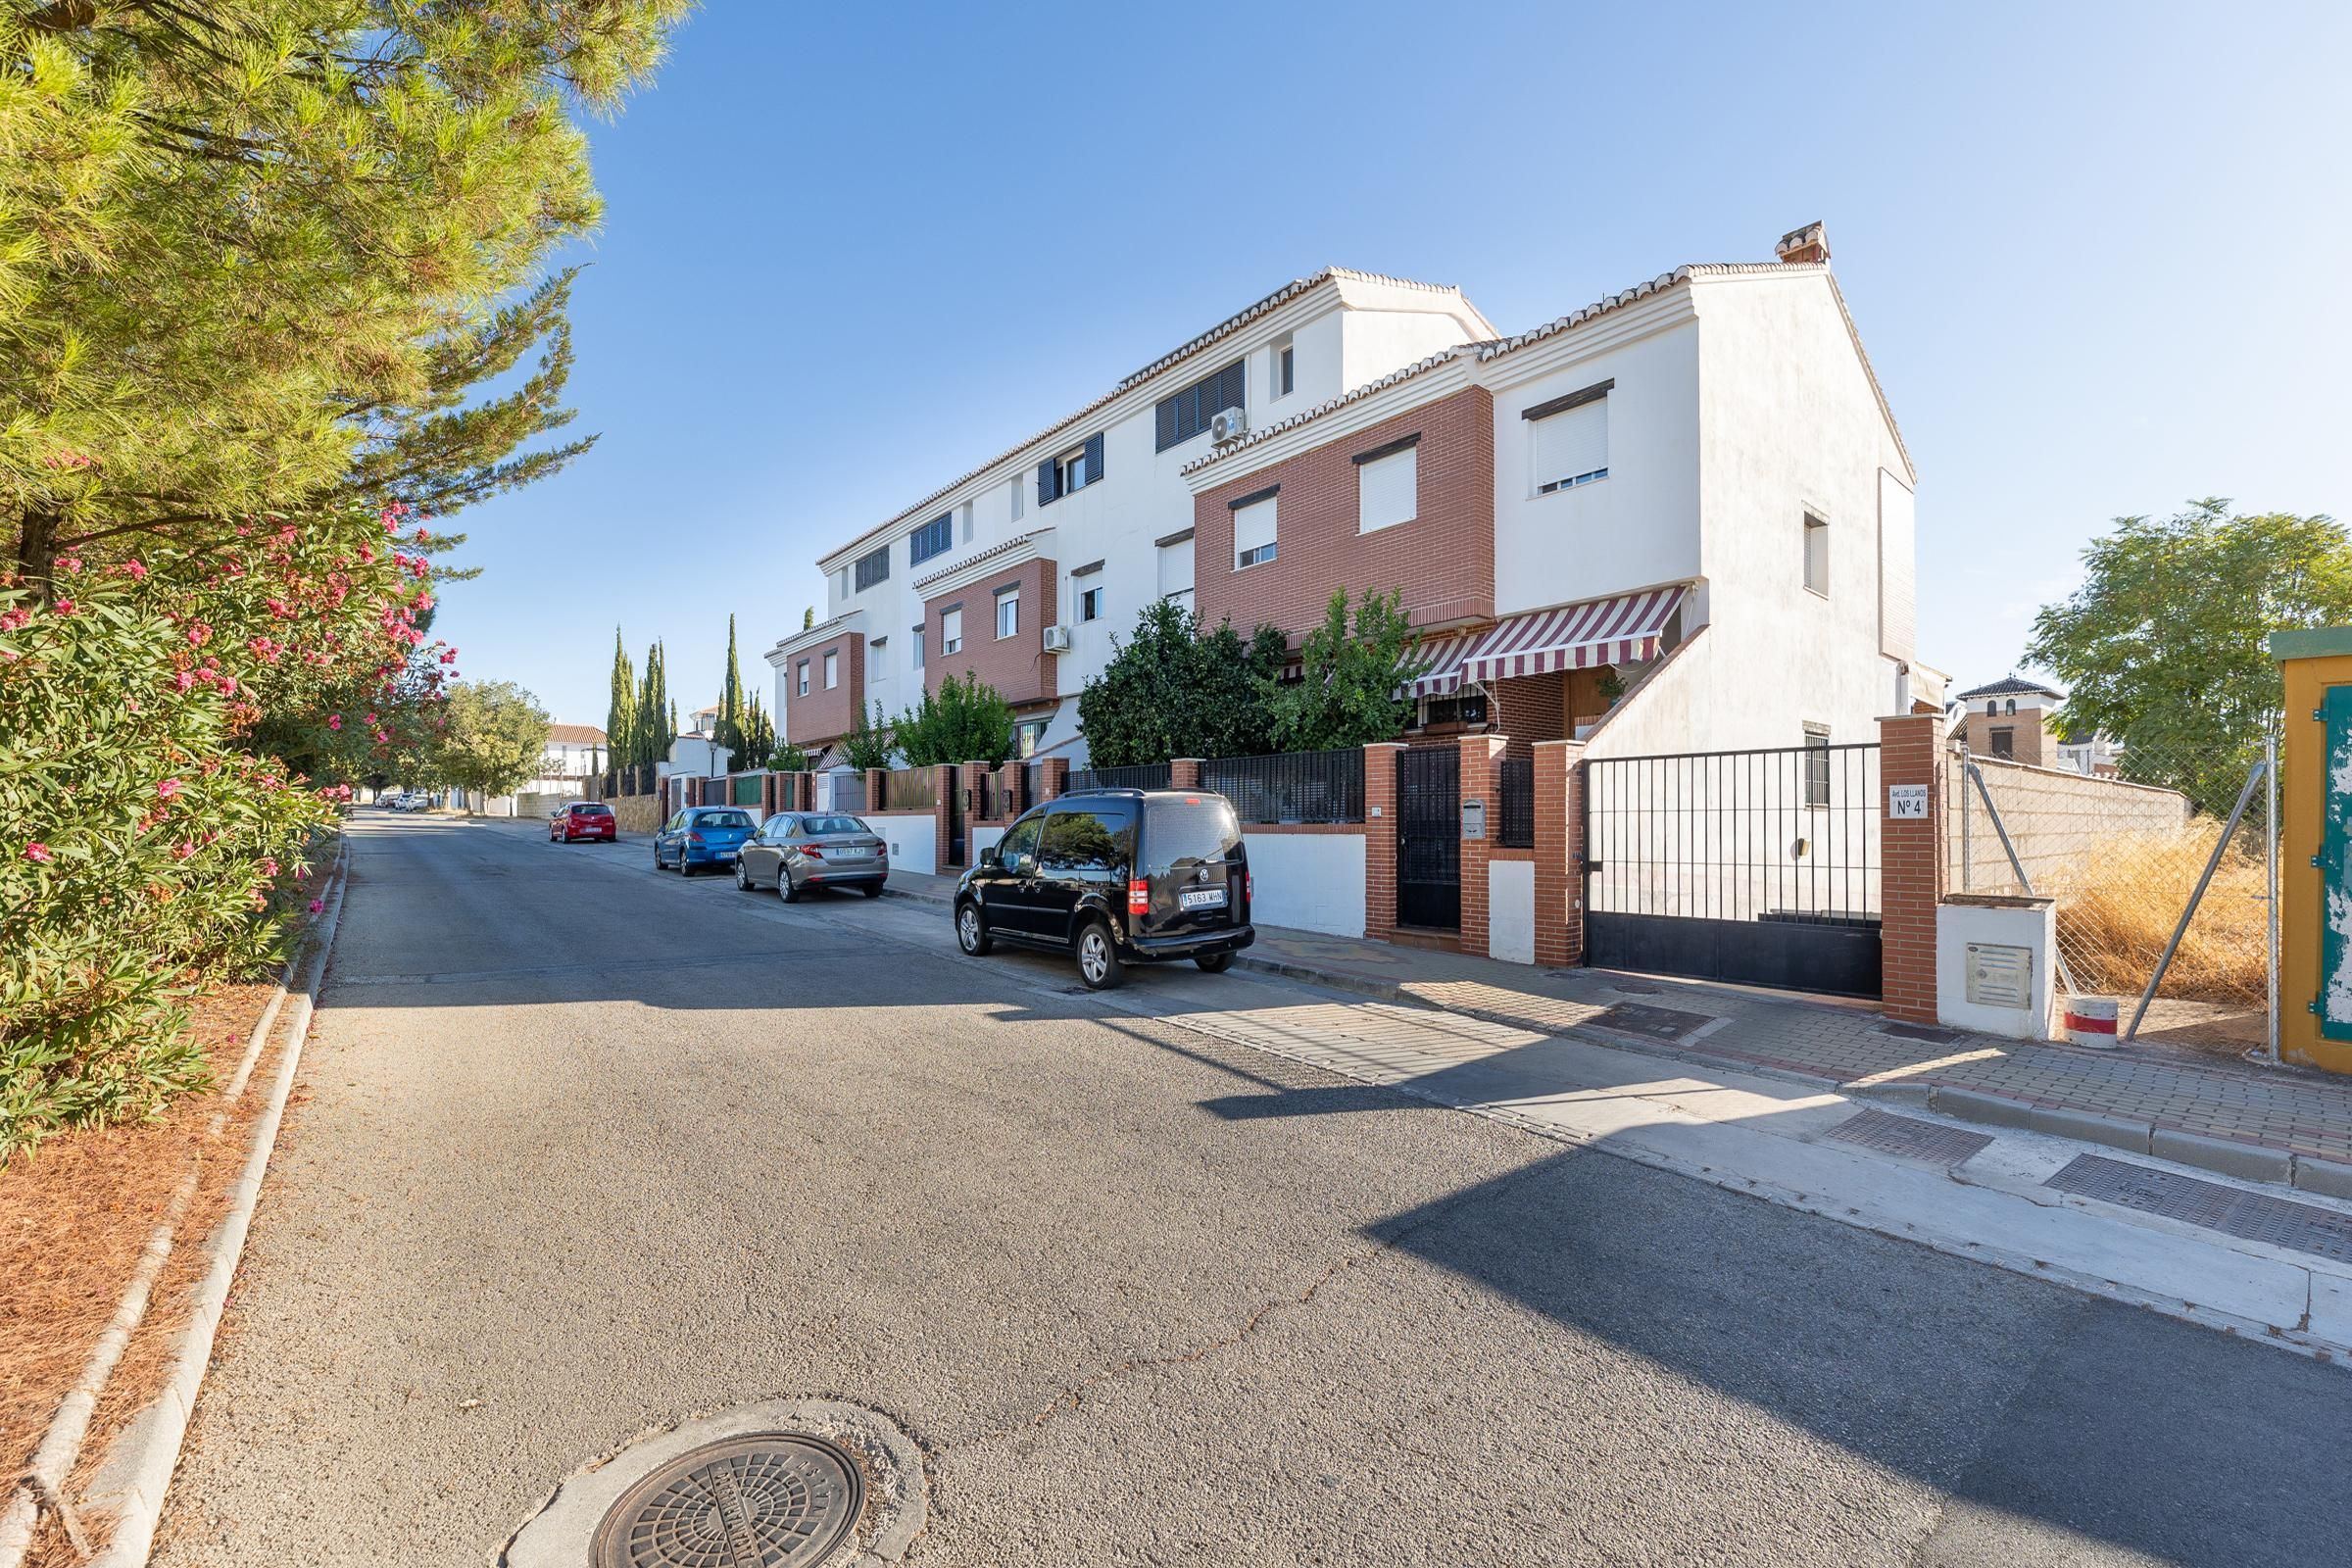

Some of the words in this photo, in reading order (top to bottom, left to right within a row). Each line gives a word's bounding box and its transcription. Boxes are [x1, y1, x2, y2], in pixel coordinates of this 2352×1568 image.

[1914, 800, 1921, 814] 4
[1188, 893, 1206, 904] 5163
[1208, 891, 1222, 902] MHN
